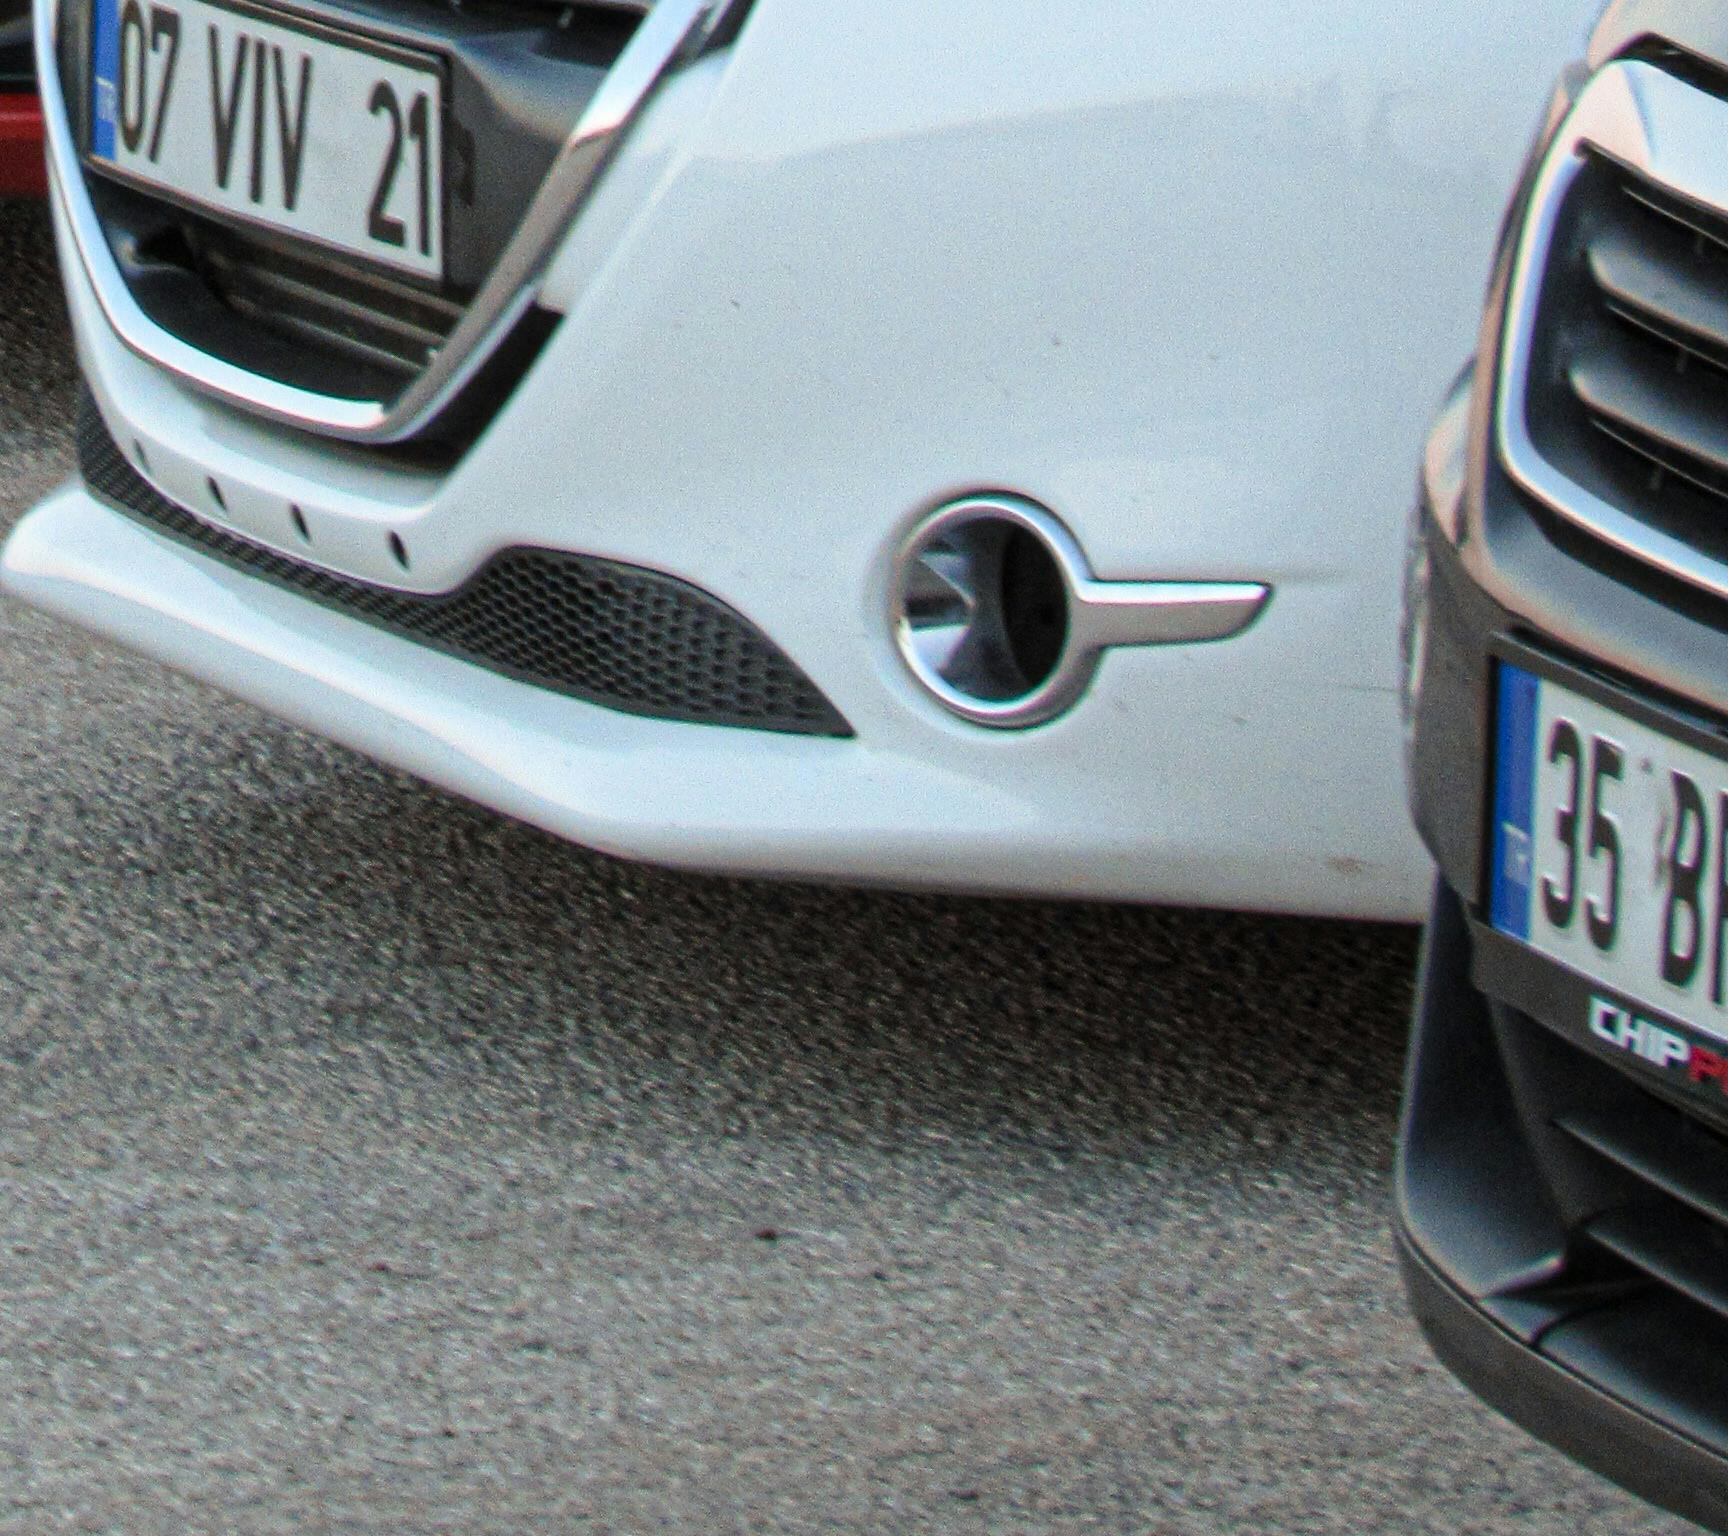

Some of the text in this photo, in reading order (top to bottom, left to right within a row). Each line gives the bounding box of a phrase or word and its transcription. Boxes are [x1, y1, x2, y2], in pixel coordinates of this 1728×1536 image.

[207, 23, 314, 212] VIV
[367, 78, 432, 258] 21
[1540, 717, 1625, 953] 35
